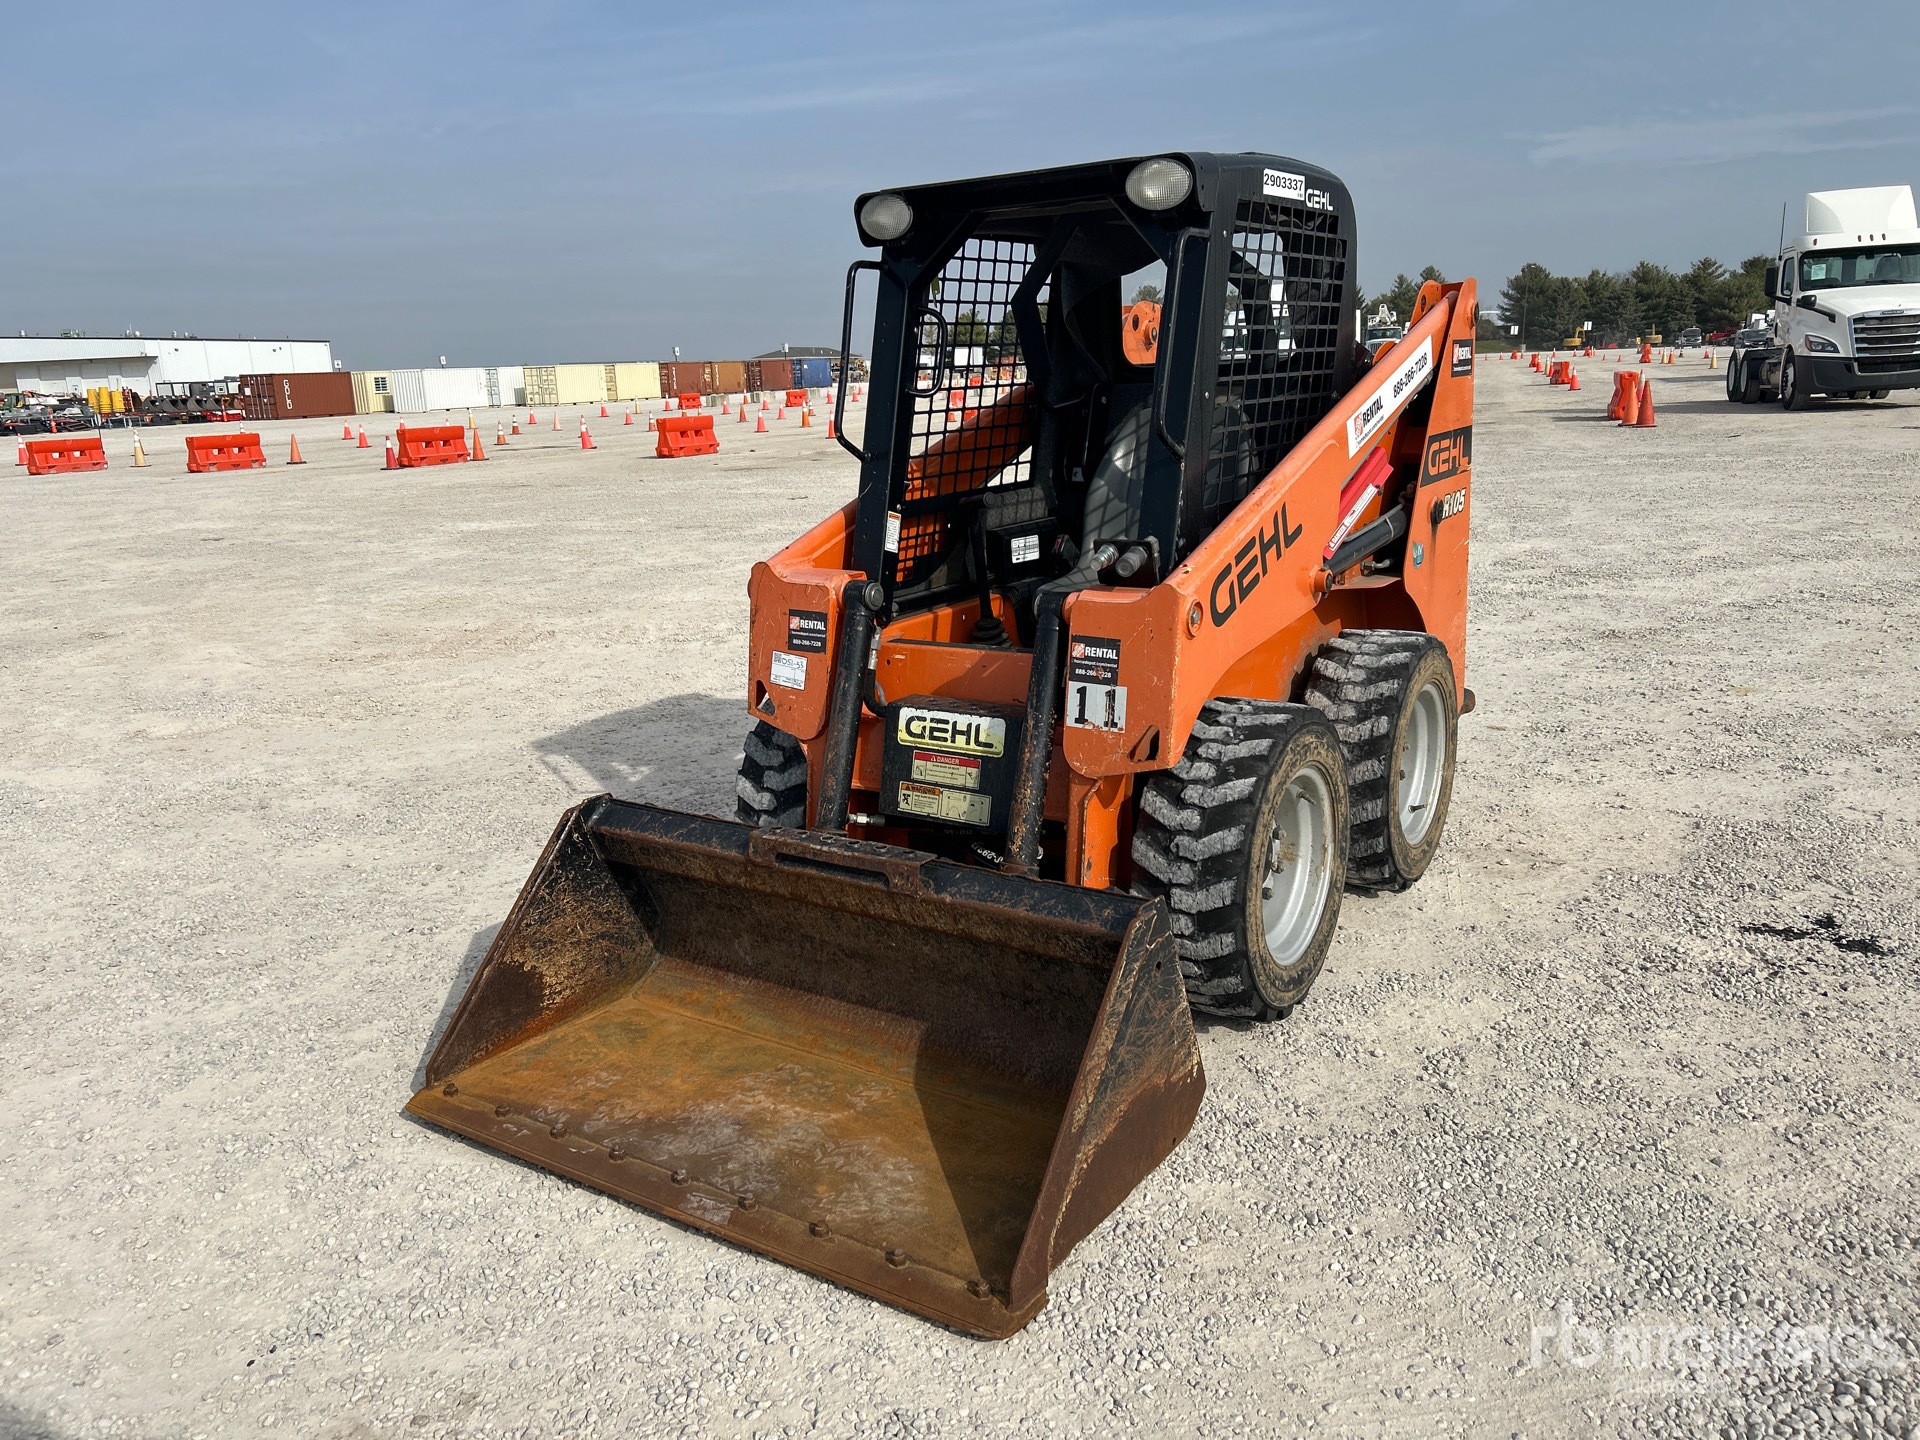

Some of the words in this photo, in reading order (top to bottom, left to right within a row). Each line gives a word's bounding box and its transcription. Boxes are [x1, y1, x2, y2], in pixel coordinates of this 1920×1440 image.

[1264, 173, 1304, 191] 2903337
[1305, 188, 1334, 211] GEHL
[1458, 346, 1472, 360] RENTAL
[1393, 352, 1428, 398] 888-266-7228
[284, 379, 293, 409] GOLD
[1362, 395, 1383, 428] RENTAL
[1428, 435, 1469, 476] GEHL
[1442, 487, 1466, 519] R105
[1210, 501, 1303, 627] GEHL
[800, 619, 826, 631] RENTAL
[1085, 646, 1118, 660] RENTAL
[905, 715, 995, 749] GEHL
[936, 756, 960, 765] DANGER
